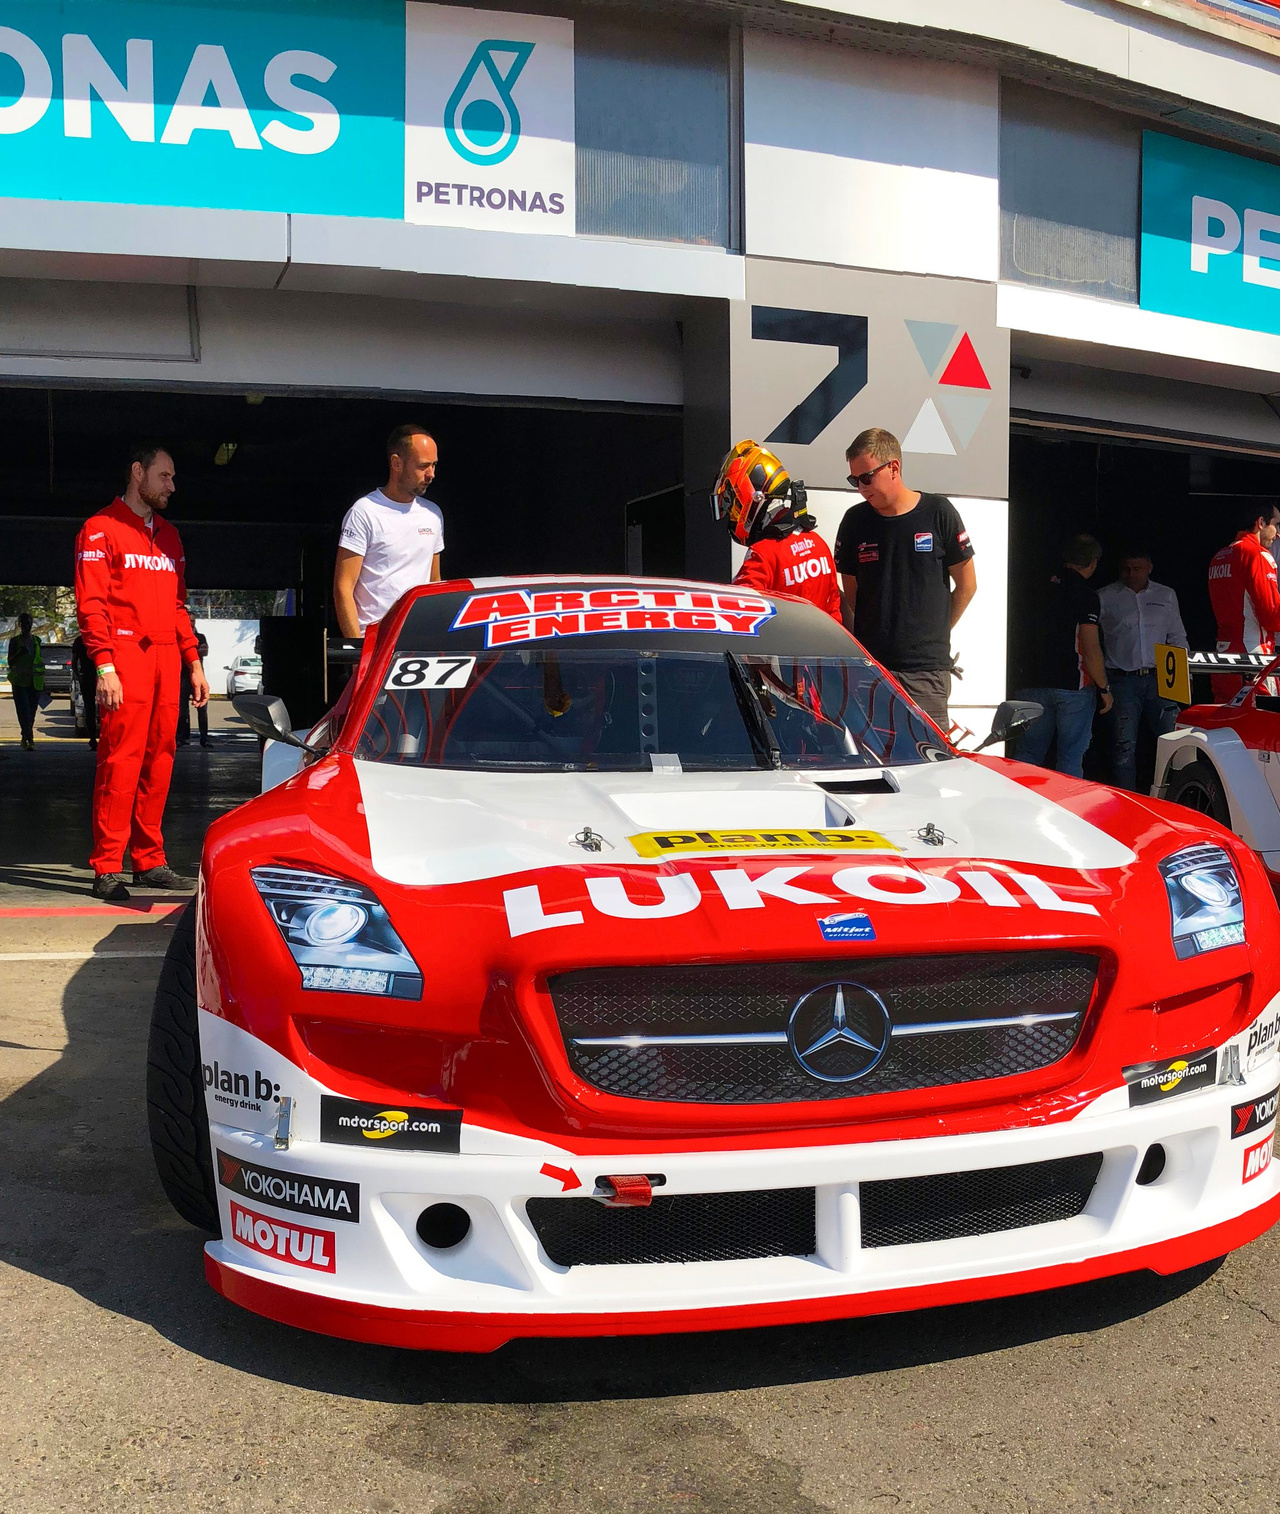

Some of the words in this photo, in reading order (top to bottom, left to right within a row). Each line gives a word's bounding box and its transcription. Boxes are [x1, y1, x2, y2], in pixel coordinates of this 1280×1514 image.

[416, 181, 565, 215] PETRONAS
[751, 305, 868, 445] 7
[124, 553, 176, 573] ЛУКОЙЛ
[784, 556, 831, 587] LUKOIL
[455, 589, 772, 627] ARCTIC
[489, 610, 758, 647] ENERGY
[392, 658, 469, 686] 87
[1165, 651, 1176, 688] 9
[653, 831, 797, 848] plan
[807, 830, 876, 843] b:
[503, 866, 1101, 938] LUKOIL
[823, 926, 872, 934] Mitjet
[1246, 1023, 1273, 1056] plan
[202, 1061, 250, 1094] plan
[255, 1070, 280, 1102] b:
[1141, 1062, 1207, 1090] motorsport.com
[214, 1094, 239, 1108] energy
[239, 1099, 262, 1112] drink
[338, 1114, 441, 1133] motorsport.com
[241, 1168, 351, 1213] YOKOHAMA
[235, 1210, 330, 1266] MOTUL
